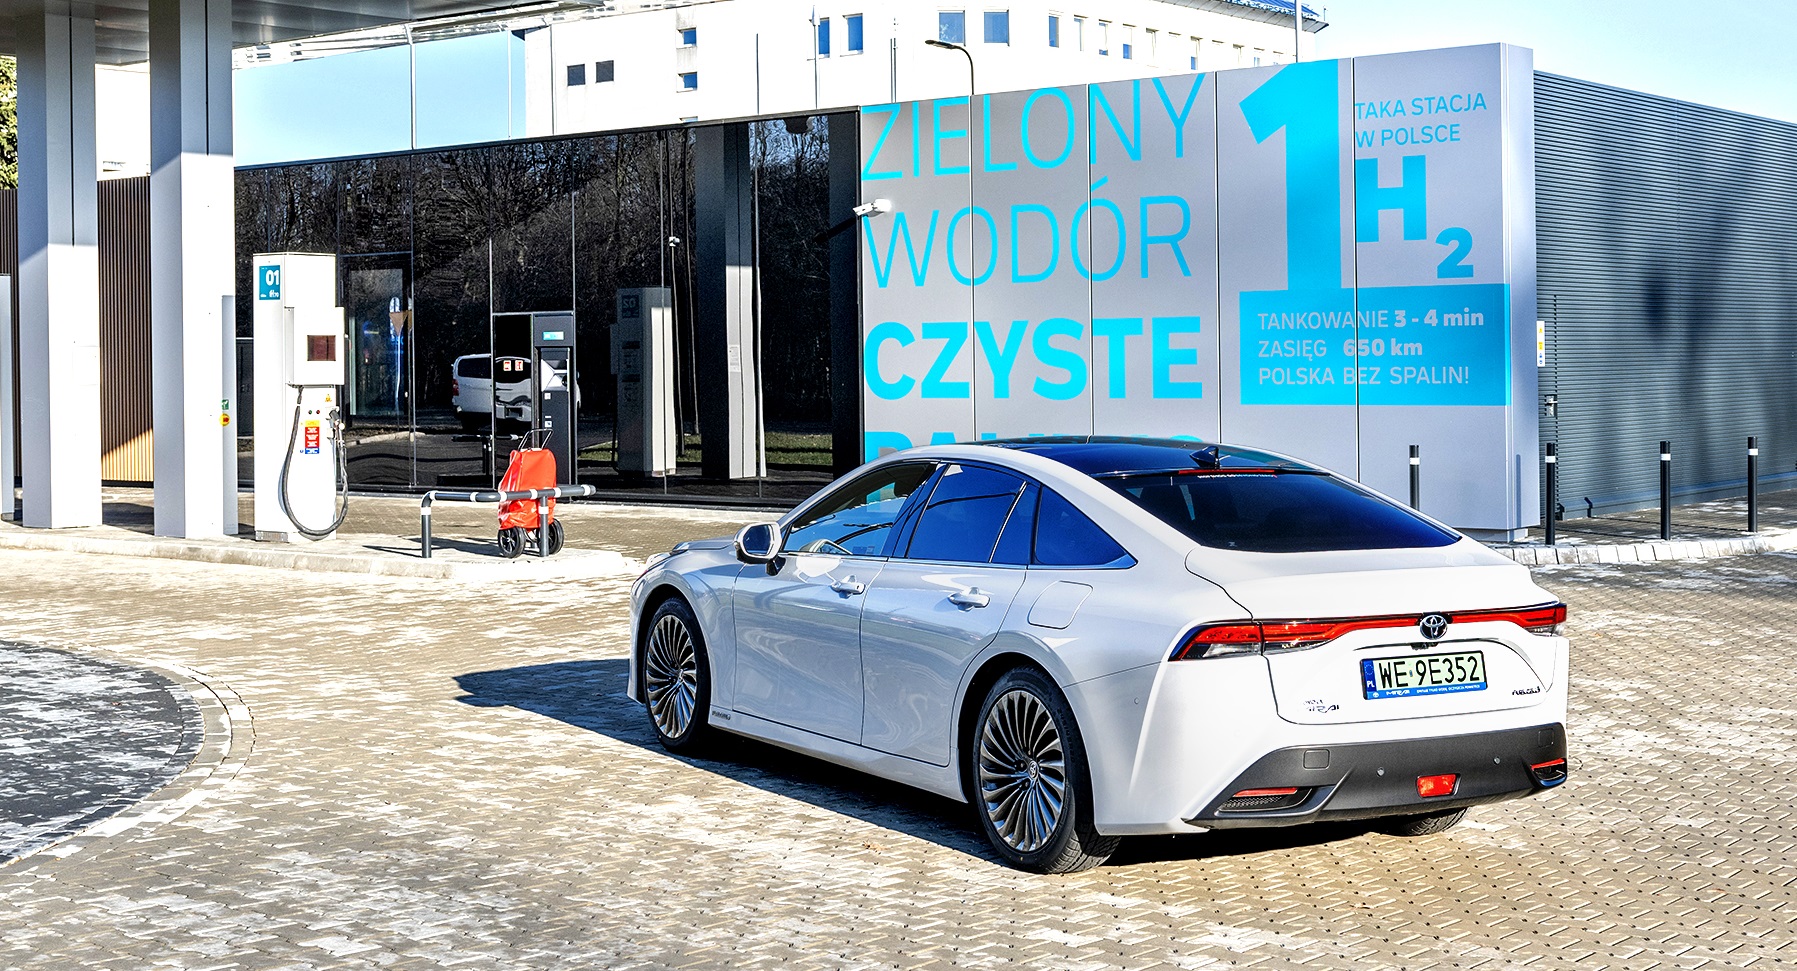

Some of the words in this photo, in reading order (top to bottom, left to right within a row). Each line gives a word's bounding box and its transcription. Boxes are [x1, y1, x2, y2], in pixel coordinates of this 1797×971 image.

[1355, 99, 1407, 120] TAKA
[1411, 93, 1487, 116] STACJA
[861, 73, 1206, 181] ZIELONY
[1355, 130, 1375, 148] W
[1381, 124, 1461, 147] POLSCE
[1239, 59, 1341, 289] 1
[863, 176, 1192, 288] WODÓR
[266, 269, 280, 286] 01
[1258, 310, 1389, 330] TANKOWANIE
[1394, 310, 1407, 328] 3
[1424, 309, 1438, 326] 4
[1443, 308, 1484, 326] min
[864, 316, 1203, 400] CZYSTE
[1258, 339, 1327, 361] ZASIĘG
[1343, 339, 1385, 356] 650
[1391, 338, 1423, 356] km
[1258, 367, 1335, 385] POLSKA
[1343, 367, 1381, 384] BEZ
[1390, 366, 1469, 384] SPALIN!
[1367, 680, 1375, 688] PL
[1379, 661, 1408, 689] WE
[1416, 656, 1480, 685] 9E352
